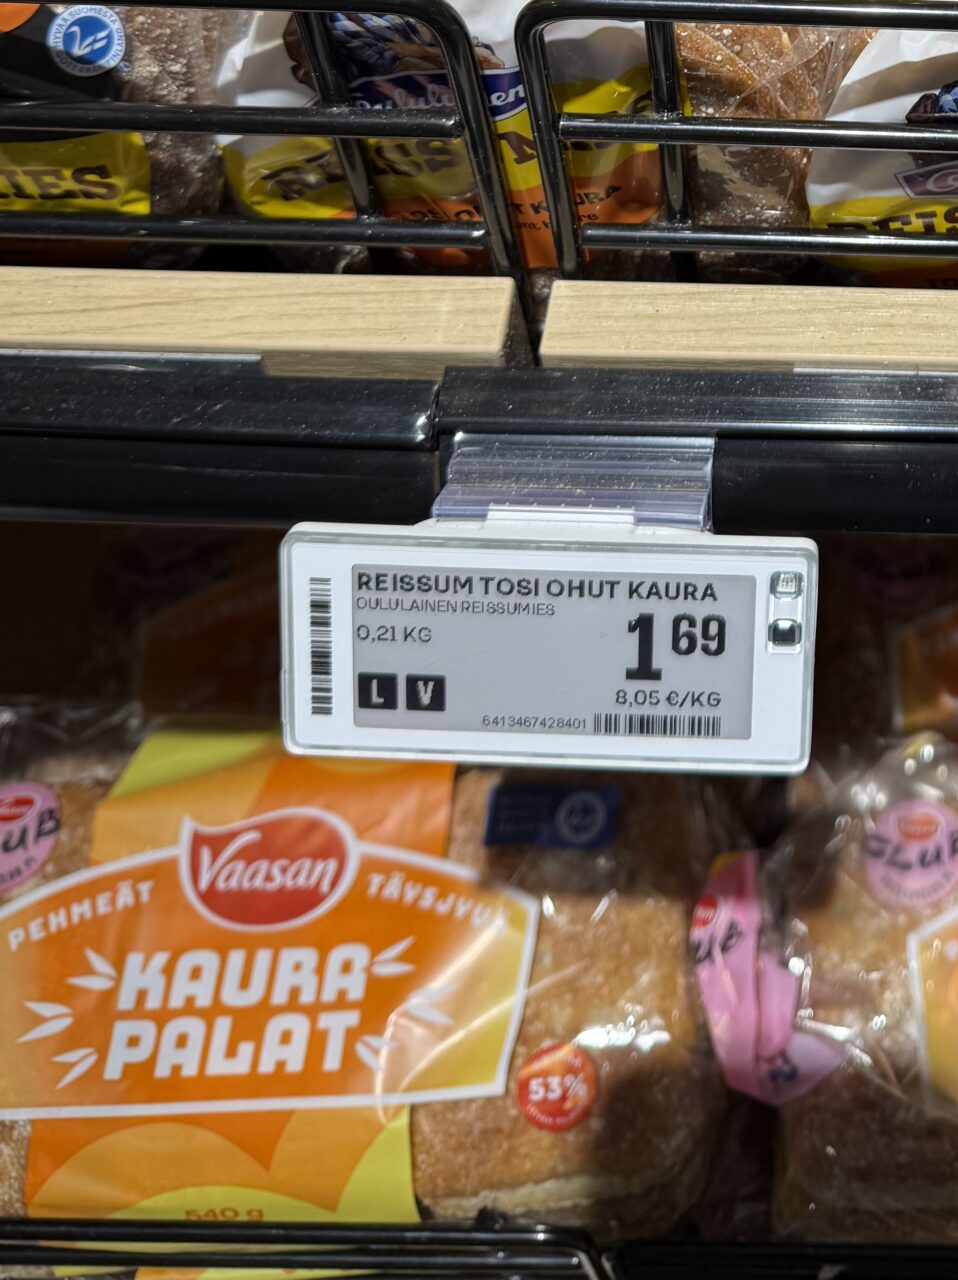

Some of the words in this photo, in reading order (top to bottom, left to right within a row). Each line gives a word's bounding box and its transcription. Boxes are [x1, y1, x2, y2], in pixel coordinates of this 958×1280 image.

[357, 572, 474, 596] REISSUM
[479, 576, 540, 597] TOSI
[546, 578, 621, 599] OHUT
[628, 580, 718, 601] KAURA
[356, 596, 458, 614] OULULAINEN
[460, 600, 556, 617] REISSUMIES
[356, 624, 398, 644] 0,21
[403, 626, 432, 643] KG
[625, 612, 662, 681] 1
[671, 613, 727, 657] 69
[615, 689, 661, 708] 8,05
[665, 690, 722, 708] €/KG
[482, 714, 587, 730] 6413467428401
[199, 829, 338, 894] Vaasan
[7, 879, 156, 951] PEHMEÄT
[116, 941, 372, 1011] KAURA
[103, 1009, 361, 1081] PALAT
[528, 1072, 588, 1103] 53%
